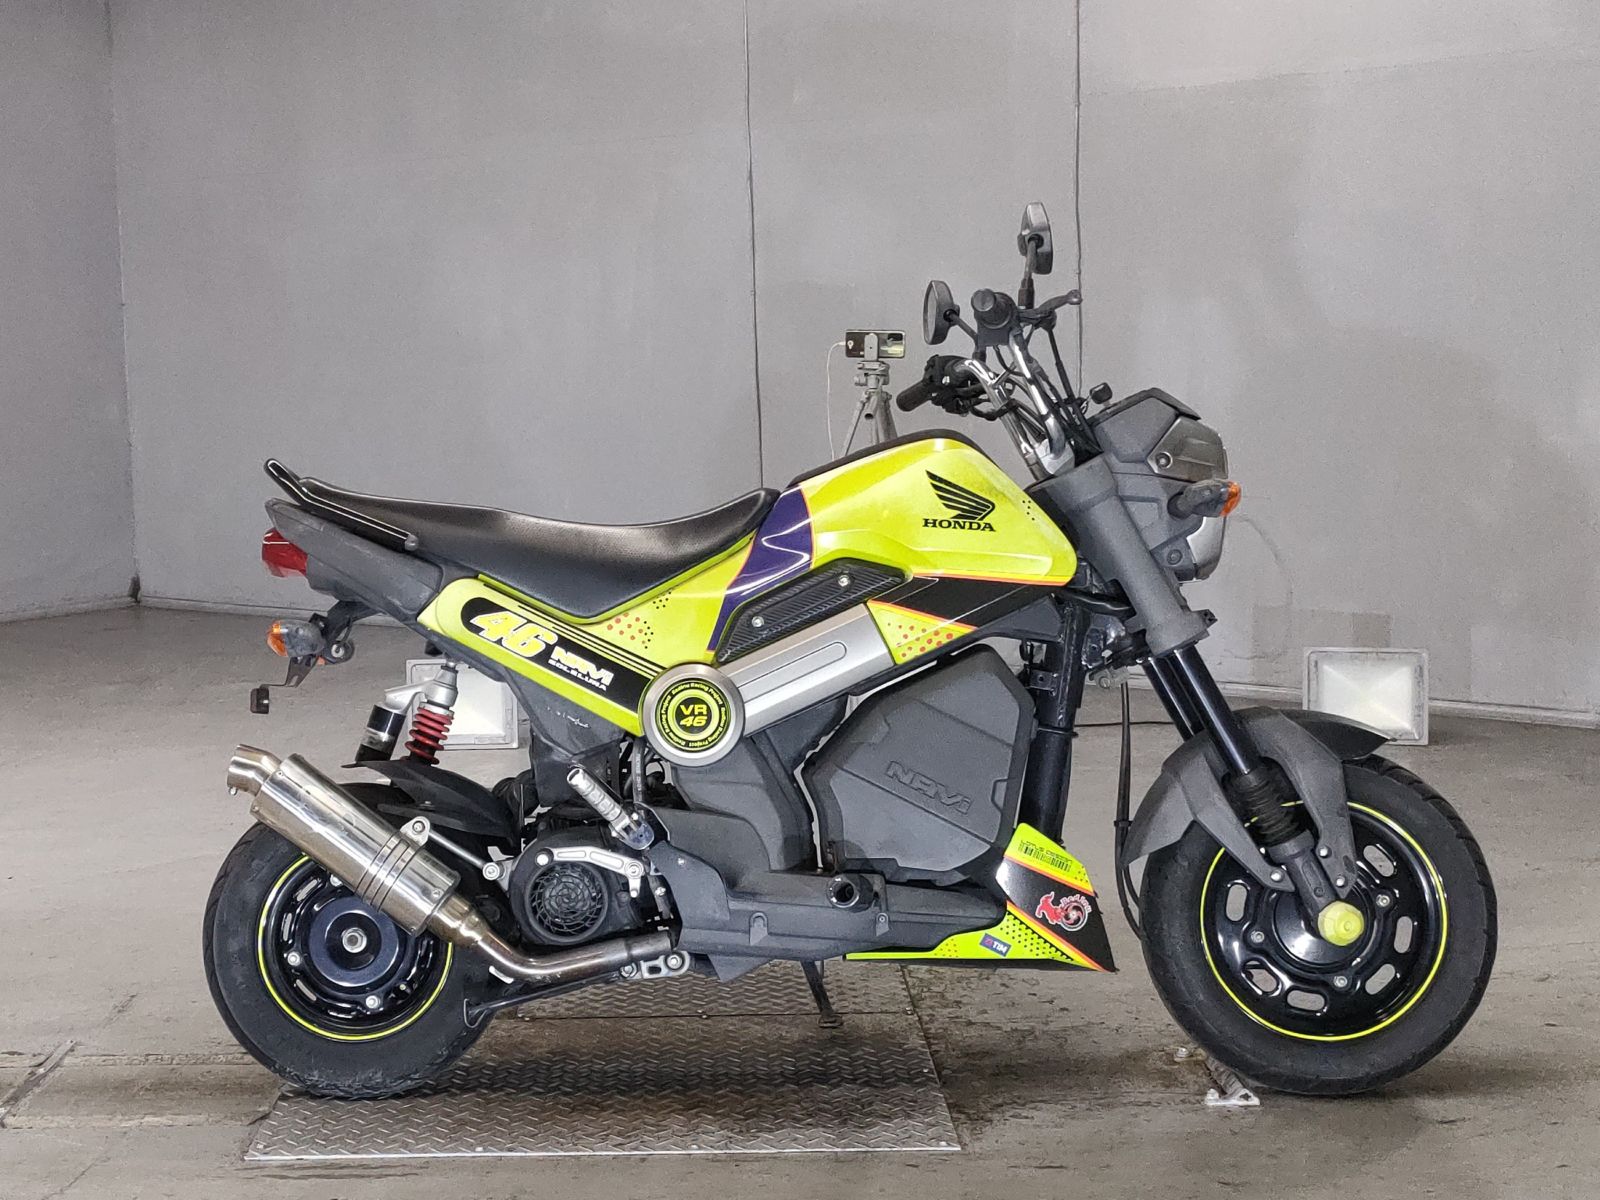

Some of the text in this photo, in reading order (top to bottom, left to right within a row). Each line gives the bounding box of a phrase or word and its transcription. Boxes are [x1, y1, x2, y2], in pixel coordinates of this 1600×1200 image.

[922, 518, 996, 532] HONDA
[469, 611, 559, 658] 46
[550, 645, 615, 687] NAVI
[680, 704, 708, 715] VR
[679, 716, 708, 727] 46
[885, 760, 974, 815] NAVI
[992, 940, 1008, 954] TIM
